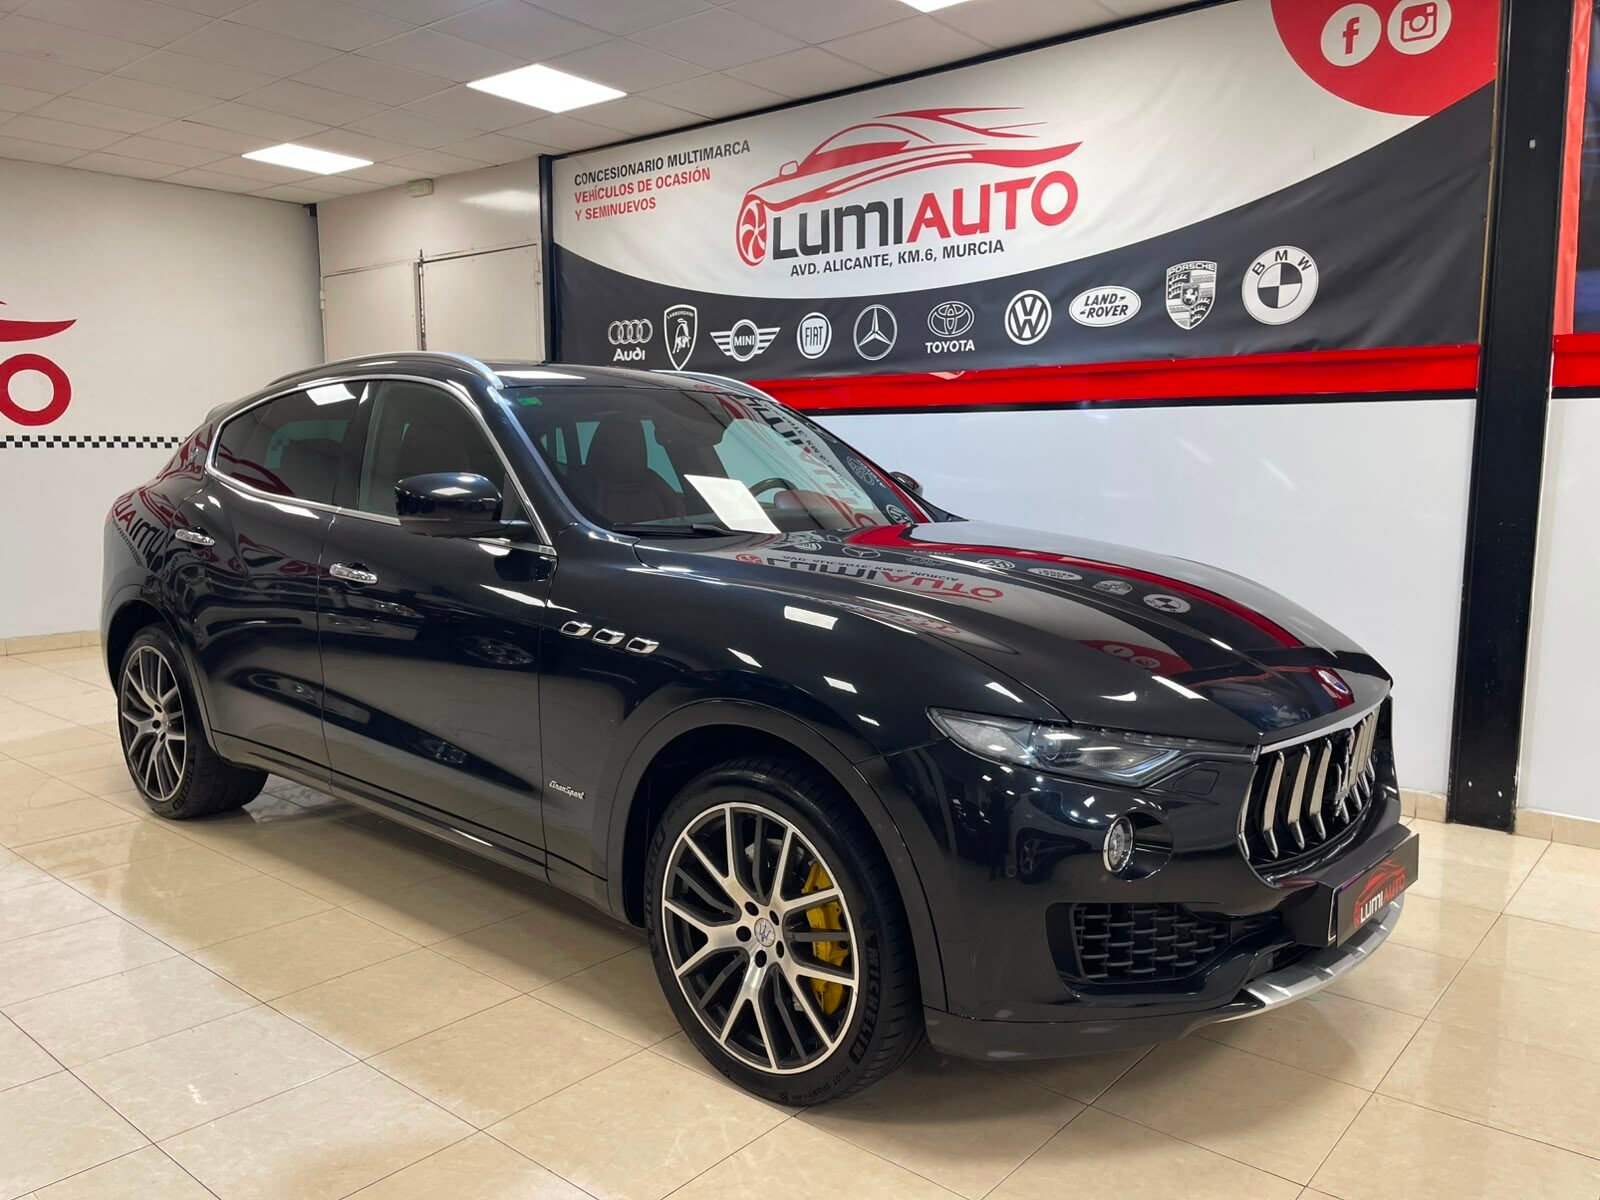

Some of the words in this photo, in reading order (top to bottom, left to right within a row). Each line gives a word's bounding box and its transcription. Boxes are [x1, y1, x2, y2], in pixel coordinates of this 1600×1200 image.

[574, 157, 664, 187] CONCESIONARIO
[667, 139, 751, 169] MULTIMARCA
[574, 182, 634, 204] VEHÍCULOS
[637, 178, 653, 193] DE
[655, 166, 711, 190] OCASIÓN
[574, 209, 583, 222] Y
[585, 196, 657, 221] SEMINUEVOS
[790, 262, 820, 278] AVD.
[823, 253, 893, 274] ALICANTE,
[898, 249, 938, 265] KM.6,
[942, 239, 1005, 260] MURCIA
[1168, 262, 1216, 277] PORSCHE
[1251, 249, 1313, 277] BMW
[733, 334, 755, 347] MINI
[804, 325, 824, 347] FIAT
[925, 339, 976, 354] TOYOTA
[612, 346, 646, 362] Audi
